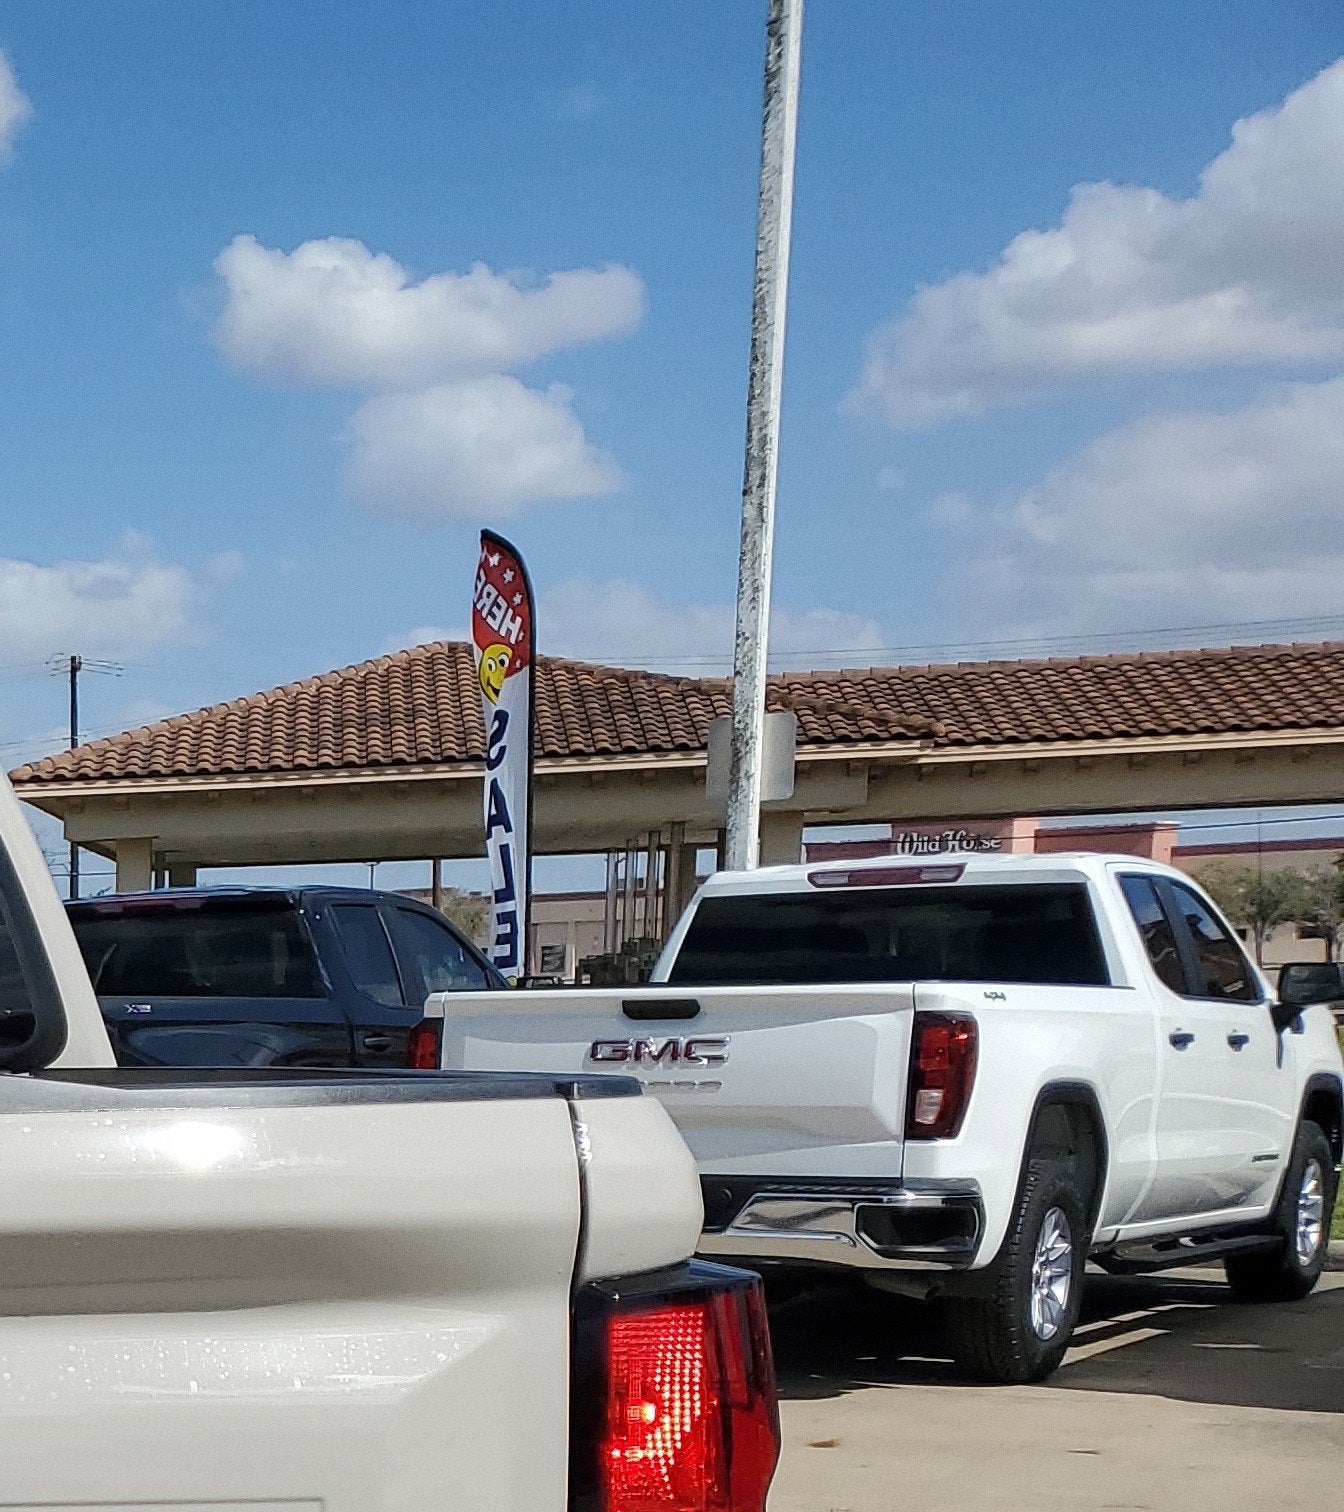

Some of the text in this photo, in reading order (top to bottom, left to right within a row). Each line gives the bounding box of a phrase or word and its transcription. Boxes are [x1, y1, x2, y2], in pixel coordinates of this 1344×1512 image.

[896, 829, 1002, 855] Wild Hose
[590, 1036, 732, 1063] GMC
